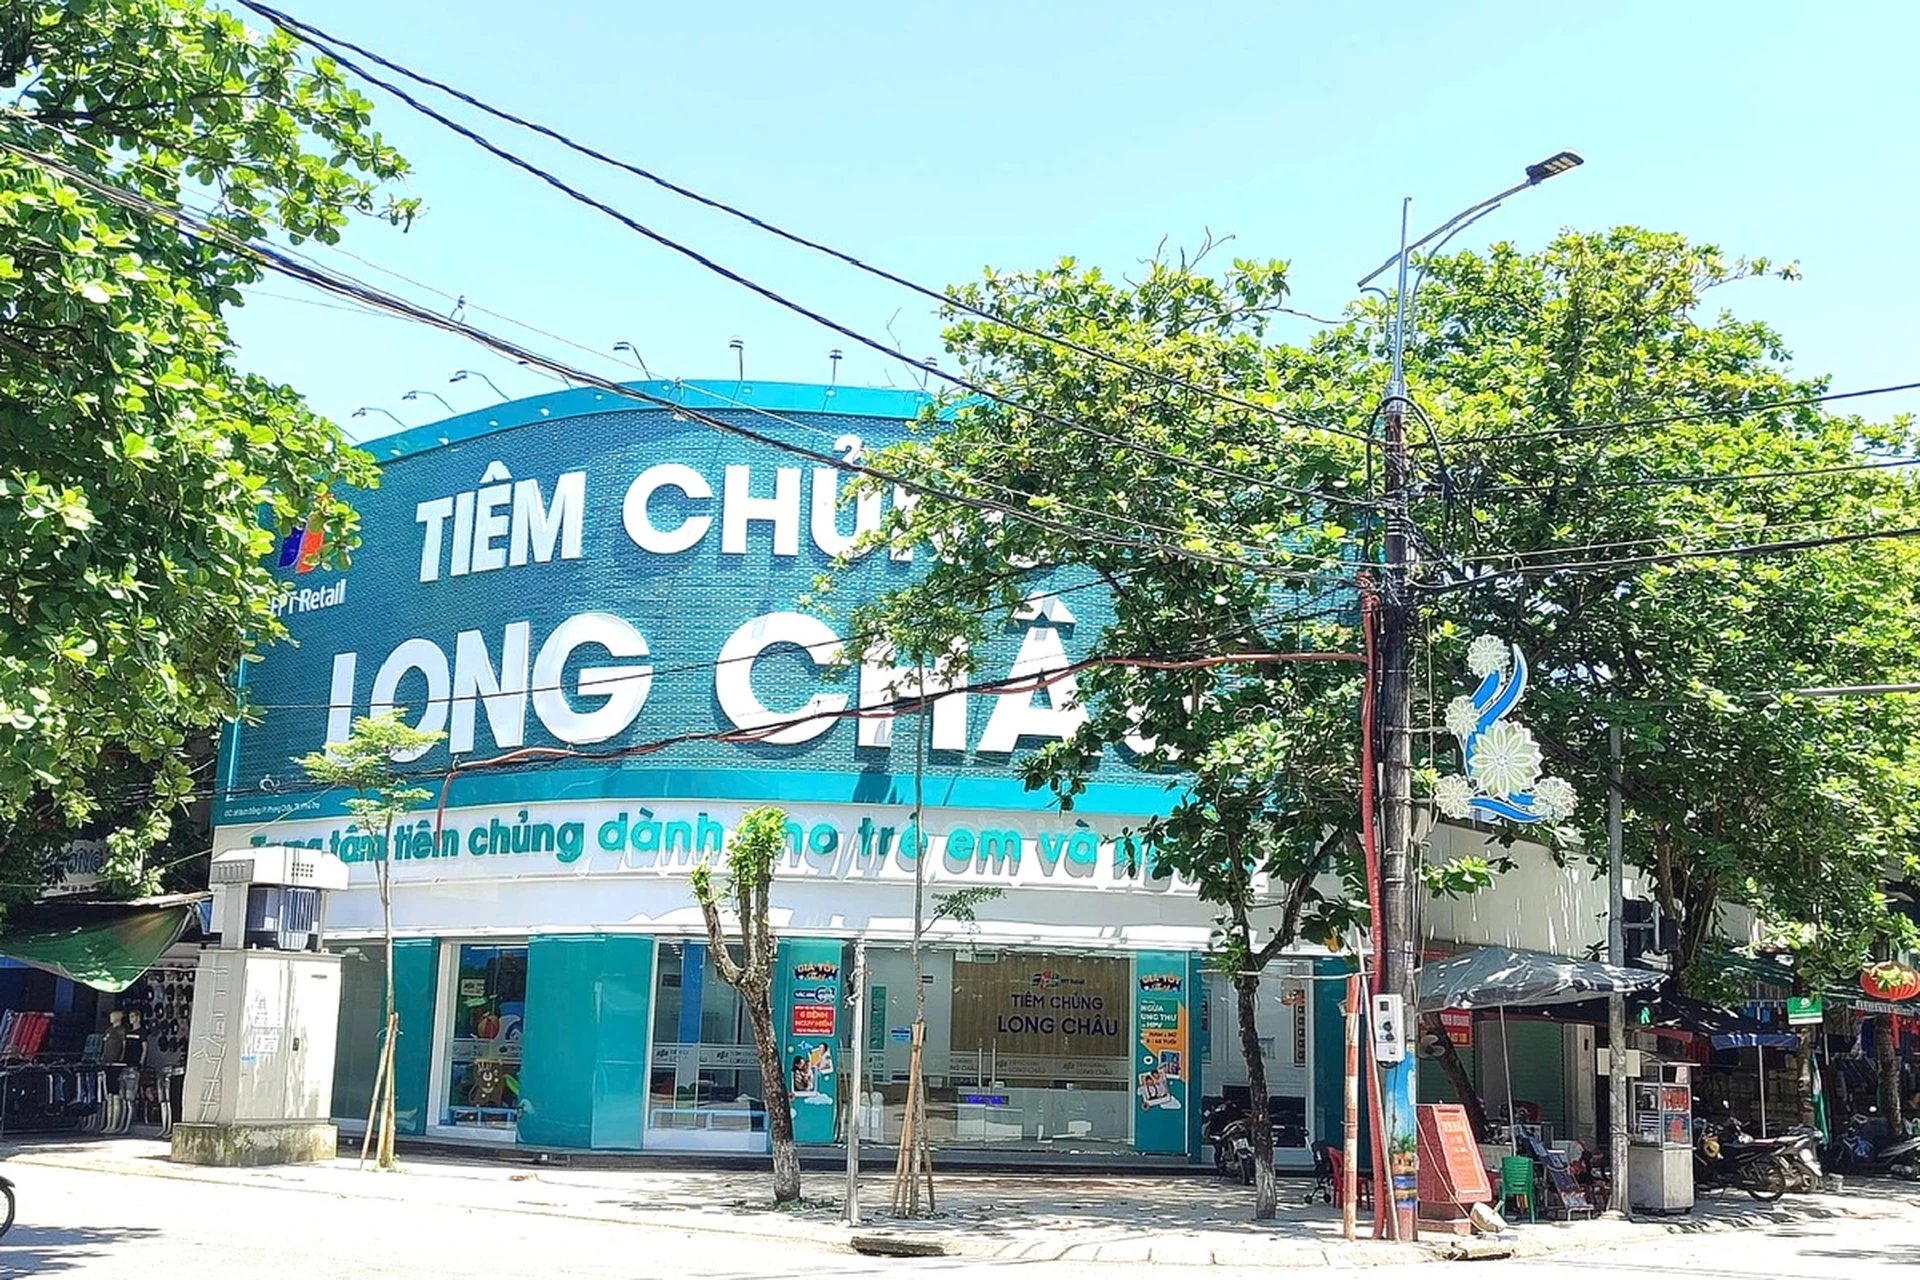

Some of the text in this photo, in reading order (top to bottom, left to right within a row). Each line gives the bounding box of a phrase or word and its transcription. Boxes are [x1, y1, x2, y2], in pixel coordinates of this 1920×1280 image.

[415, 460, 587, 583] TIÊM
[299, 578, 347, 612] Retail
[329, 824, 387, 864] tâm
[394, 819, 459, 861] tiêm
[467, 810, 584, 865] chủng
[597, 807, 725, 852] dành
[857, 812, 930, 859] trẻ
[945, 828, 1022, 863] em
[1038, 818, 1099, 865] và
[1011, 991, 1104, 1011] TIÊM CHỦNG
[998, 1014, 1119, 1037] LONG CHÂU
